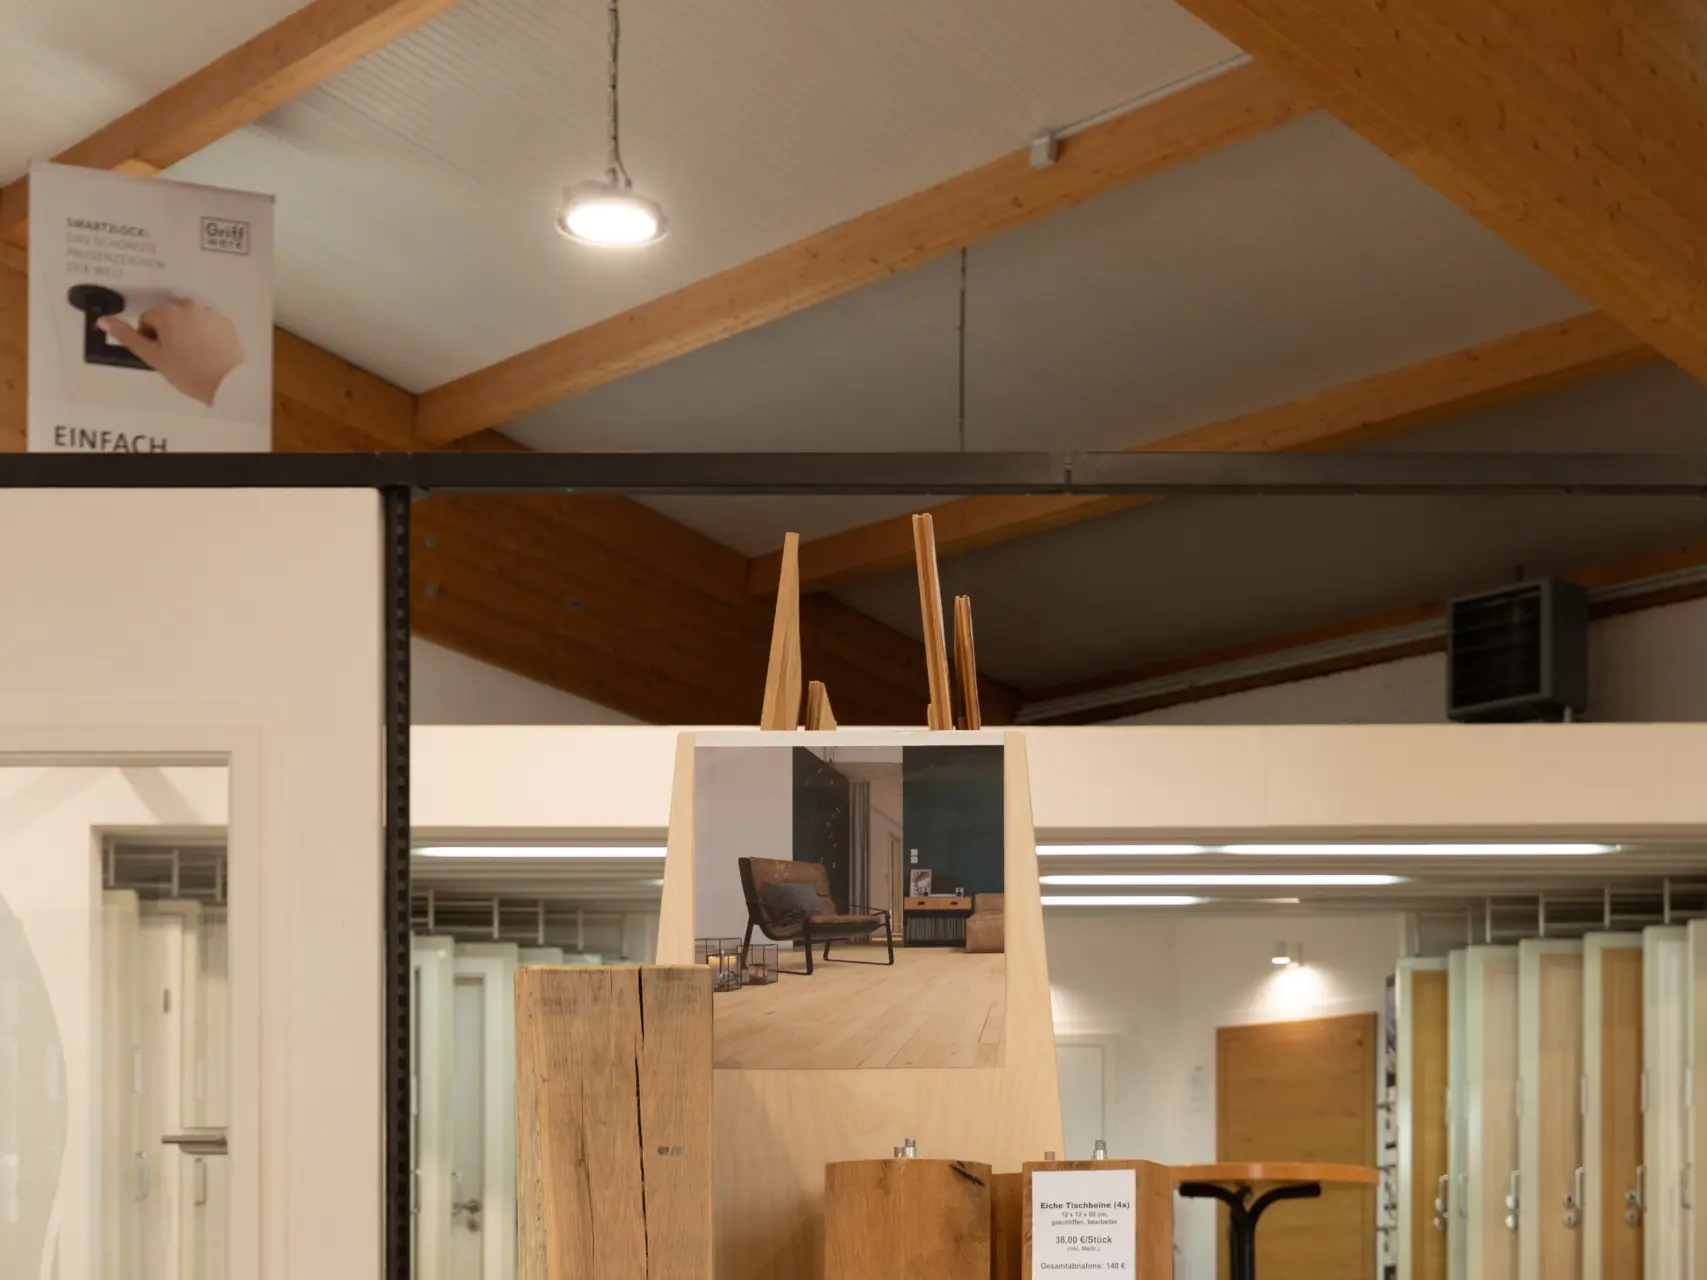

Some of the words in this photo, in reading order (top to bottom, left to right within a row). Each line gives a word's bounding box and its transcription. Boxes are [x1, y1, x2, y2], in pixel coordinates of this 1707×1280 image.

[54, 425, 168, 453] EINFACH
[1113, 1201, 1130, 1209] (4x)
[1056, 1236, 1078, 1244] 38,00
[1080, 1235, 1112, 1243] €/Stück
